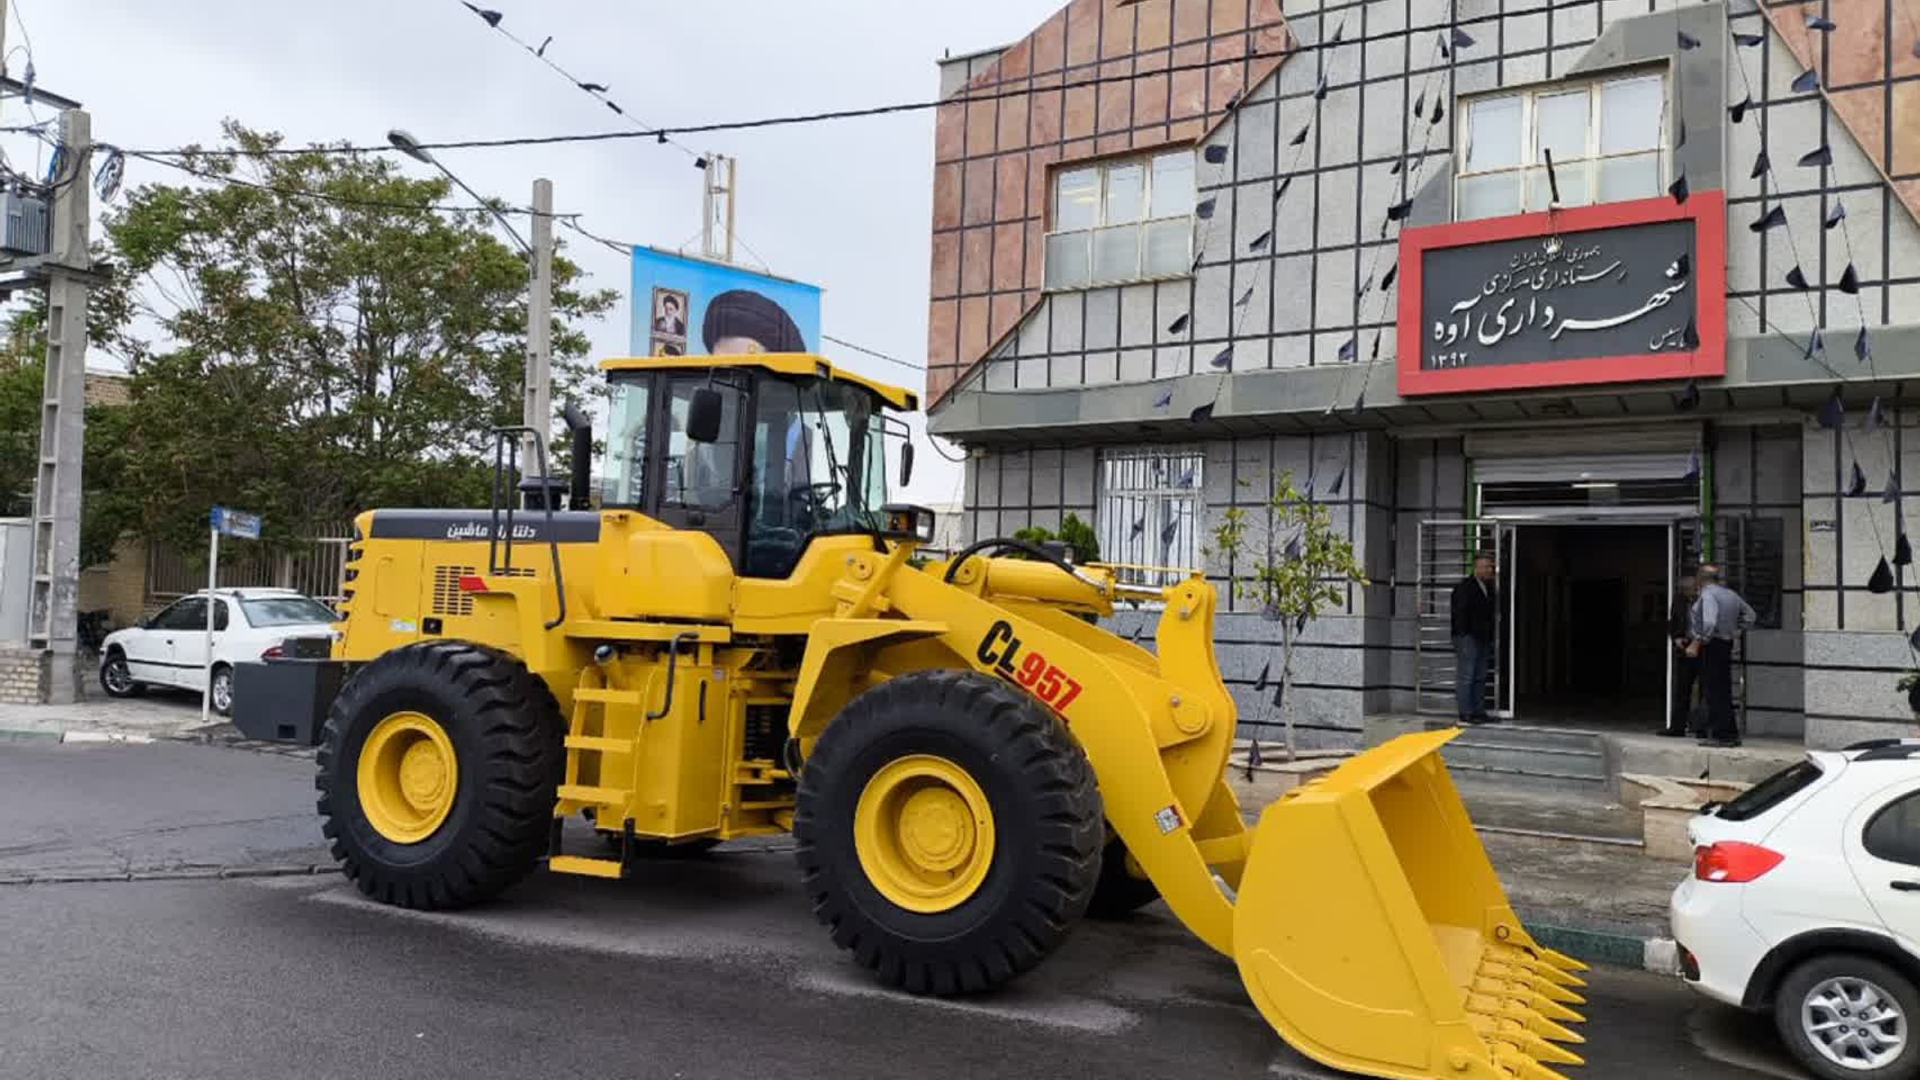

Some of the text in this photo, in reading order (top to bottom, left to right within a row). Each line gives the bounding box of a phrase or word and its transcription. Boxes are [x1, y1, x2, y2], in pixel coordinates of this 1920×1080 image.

[1434, 260, 1686, 347] شهرداری آوه
[1483, 265, 1530, 295] مرکزی
[446, 521, 536, 540] دلتا را ماشین
[977, 620, 1083, 712] CL957
